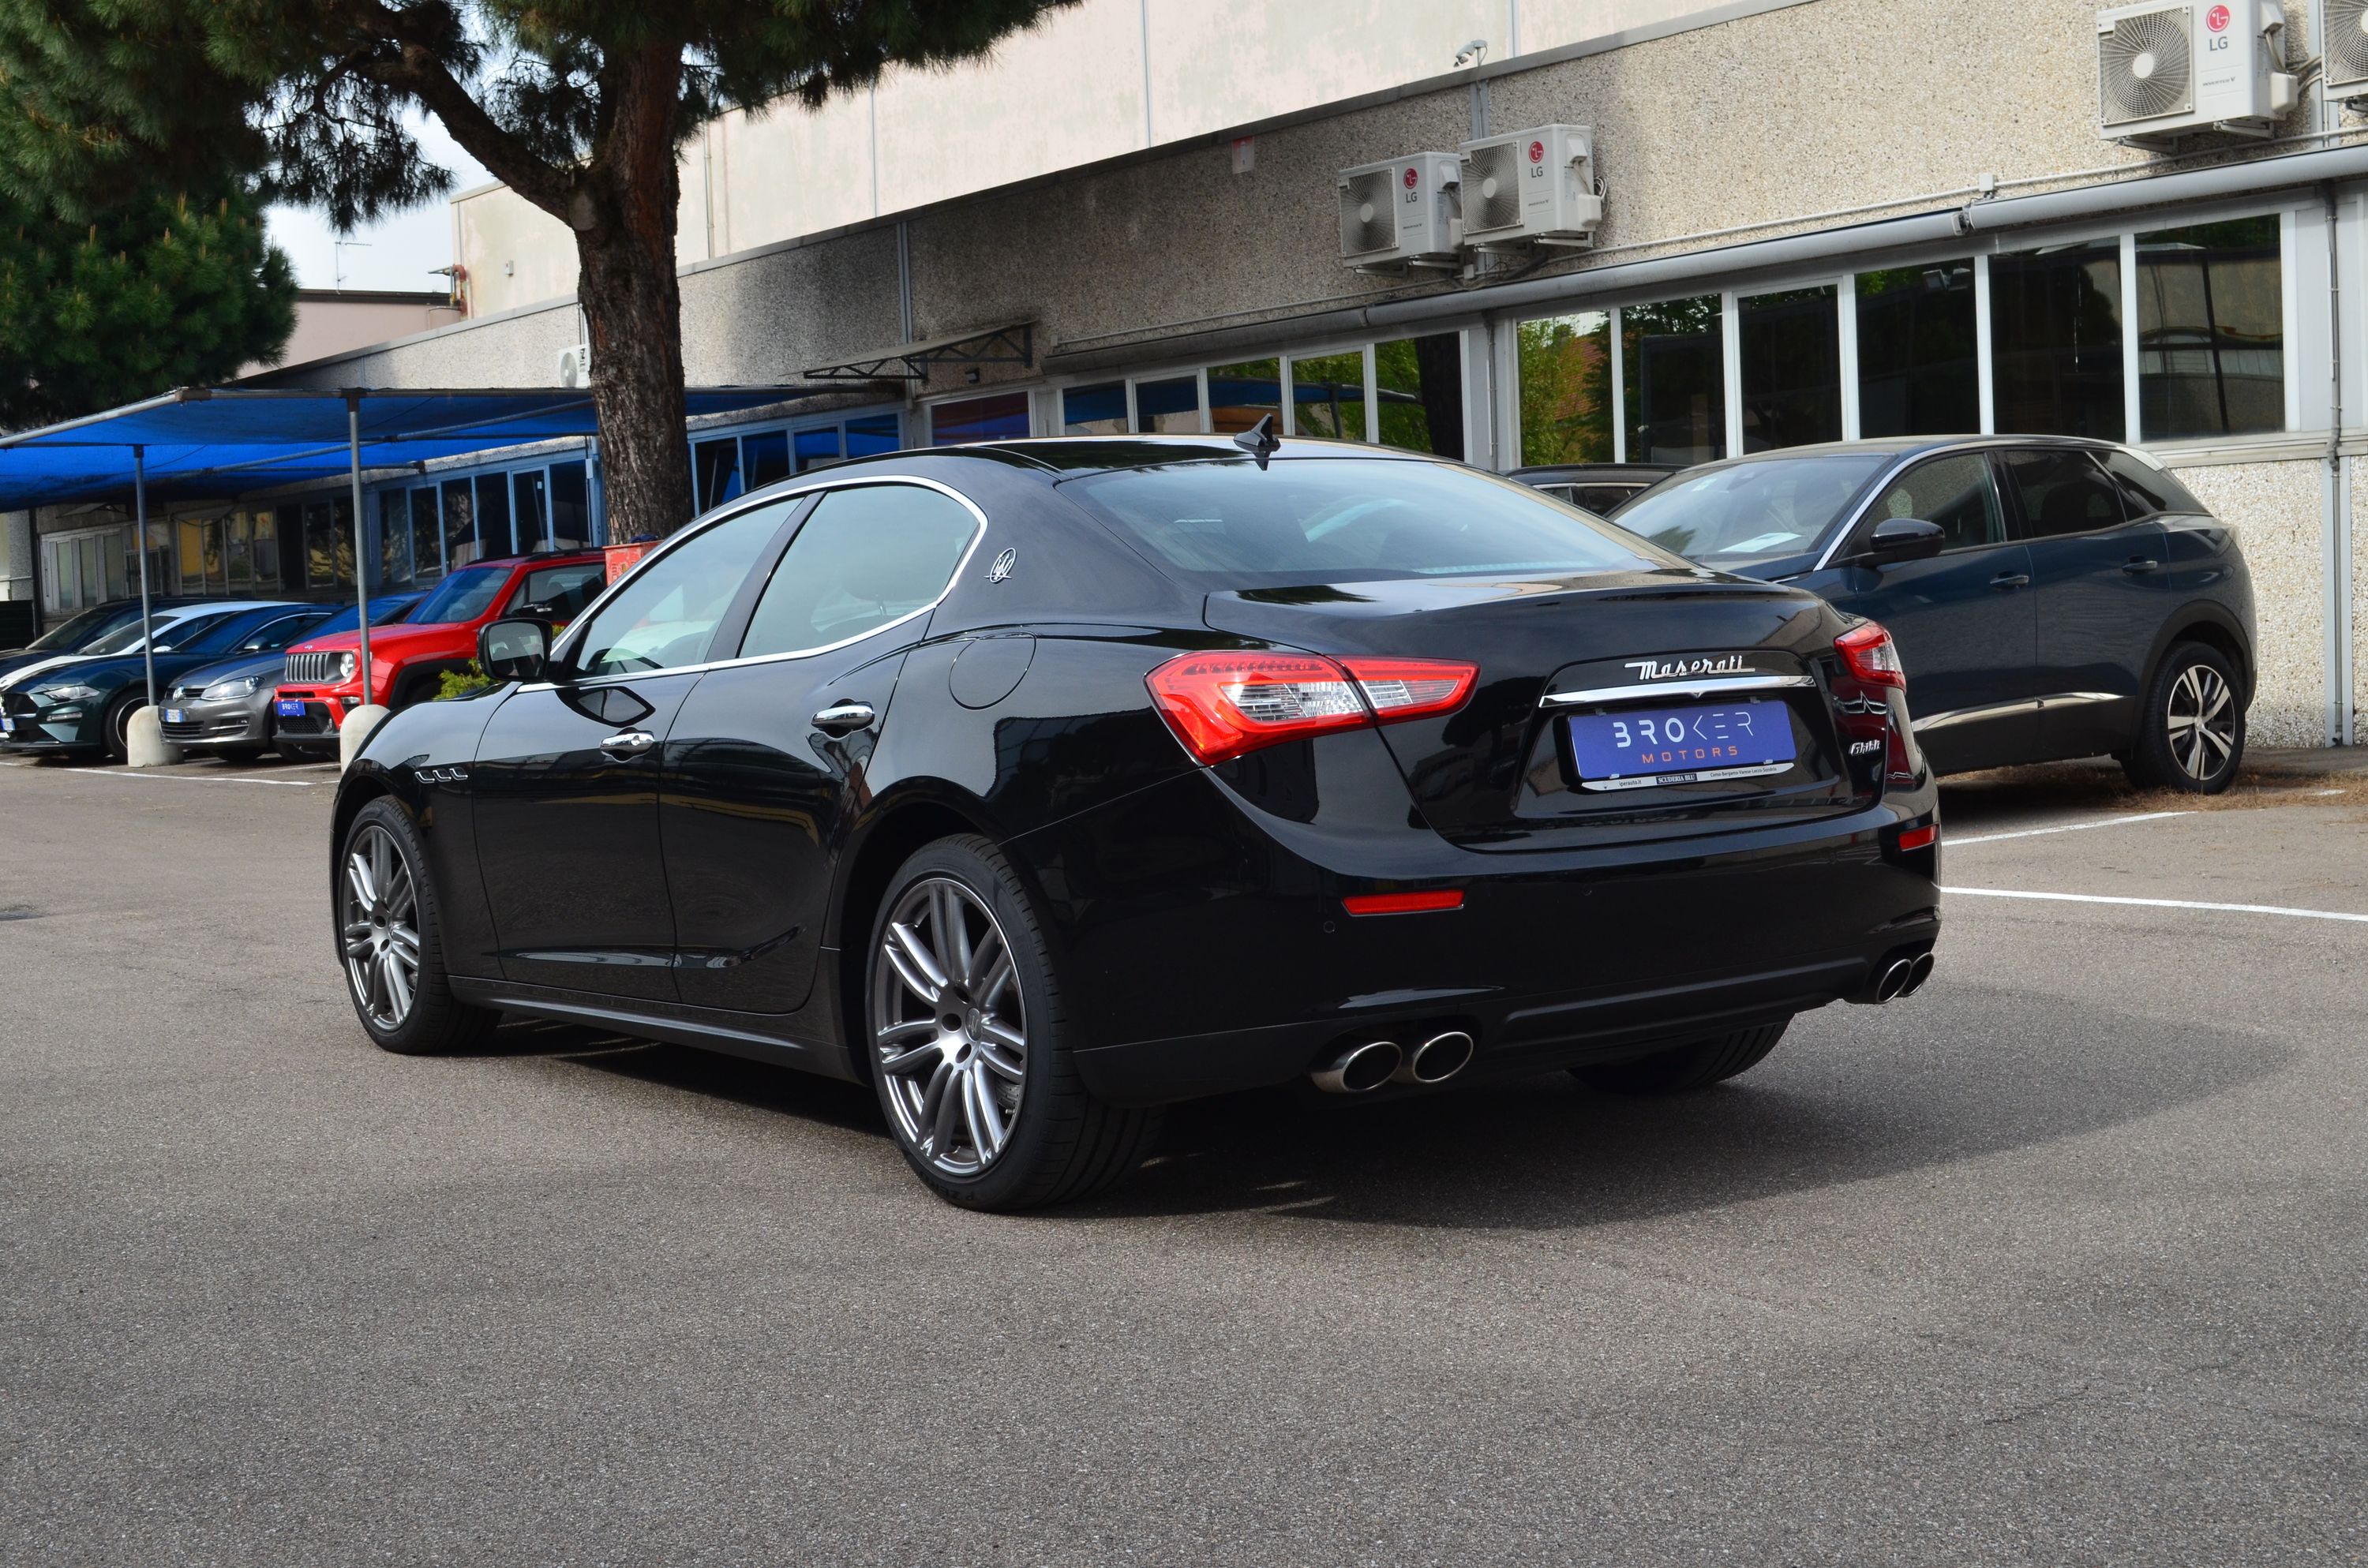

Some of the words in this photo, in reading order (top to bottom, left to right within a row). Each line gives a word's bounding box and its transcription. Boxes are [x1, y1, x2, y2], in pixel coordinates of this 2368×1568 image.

[2209, 36, 2228, 51] LG
[1531, 166, 1543, 178] LG
[1406, 192, 1418, 204] LG
[1624, 655, 1755, 680] Maserati
[1613, 711, 1754, 748] BROKER
[1641, 746, 1738, 764] MOTORS
